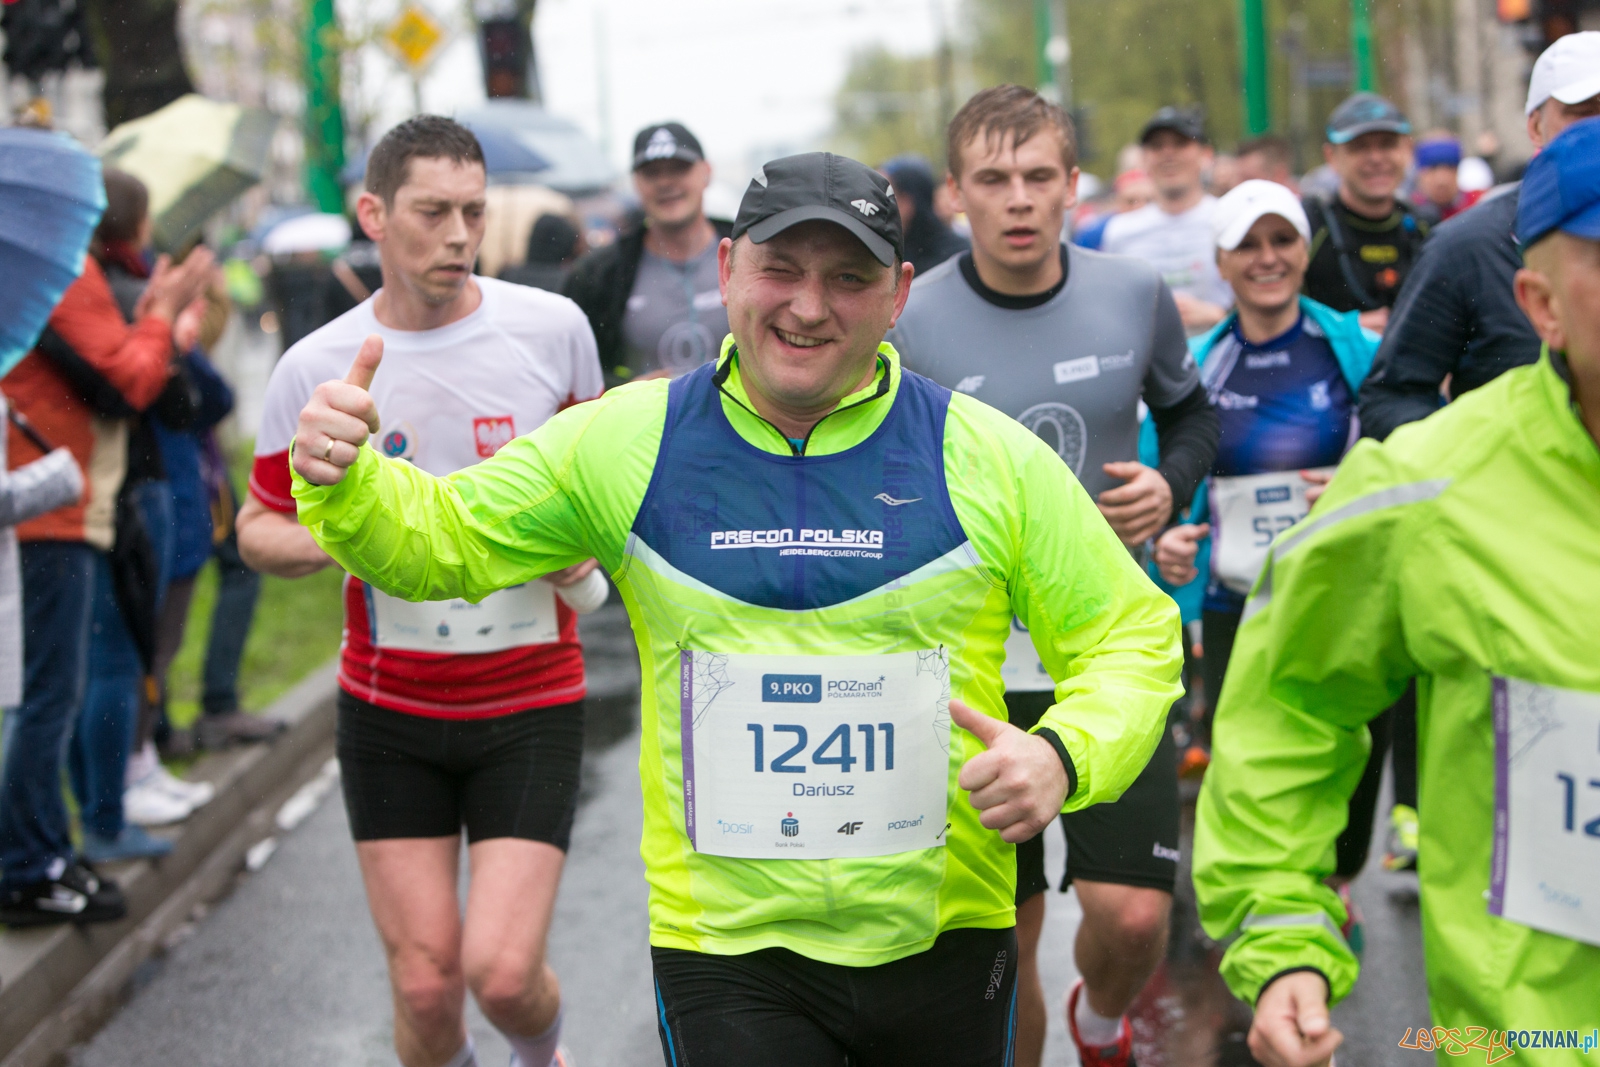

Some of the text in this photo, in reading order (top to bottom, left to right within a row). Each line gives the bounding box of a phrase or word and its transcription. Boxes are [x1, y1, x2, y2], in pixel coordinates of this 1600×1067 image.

[851, 199, 880, 217] 4F
[711, 529, 884, 544] PRECON POLSKA
[746, 722, 894, 773] 12411
[792, 783, 855, 797] Dariusz
[837, 821, 864, 835] 4F
